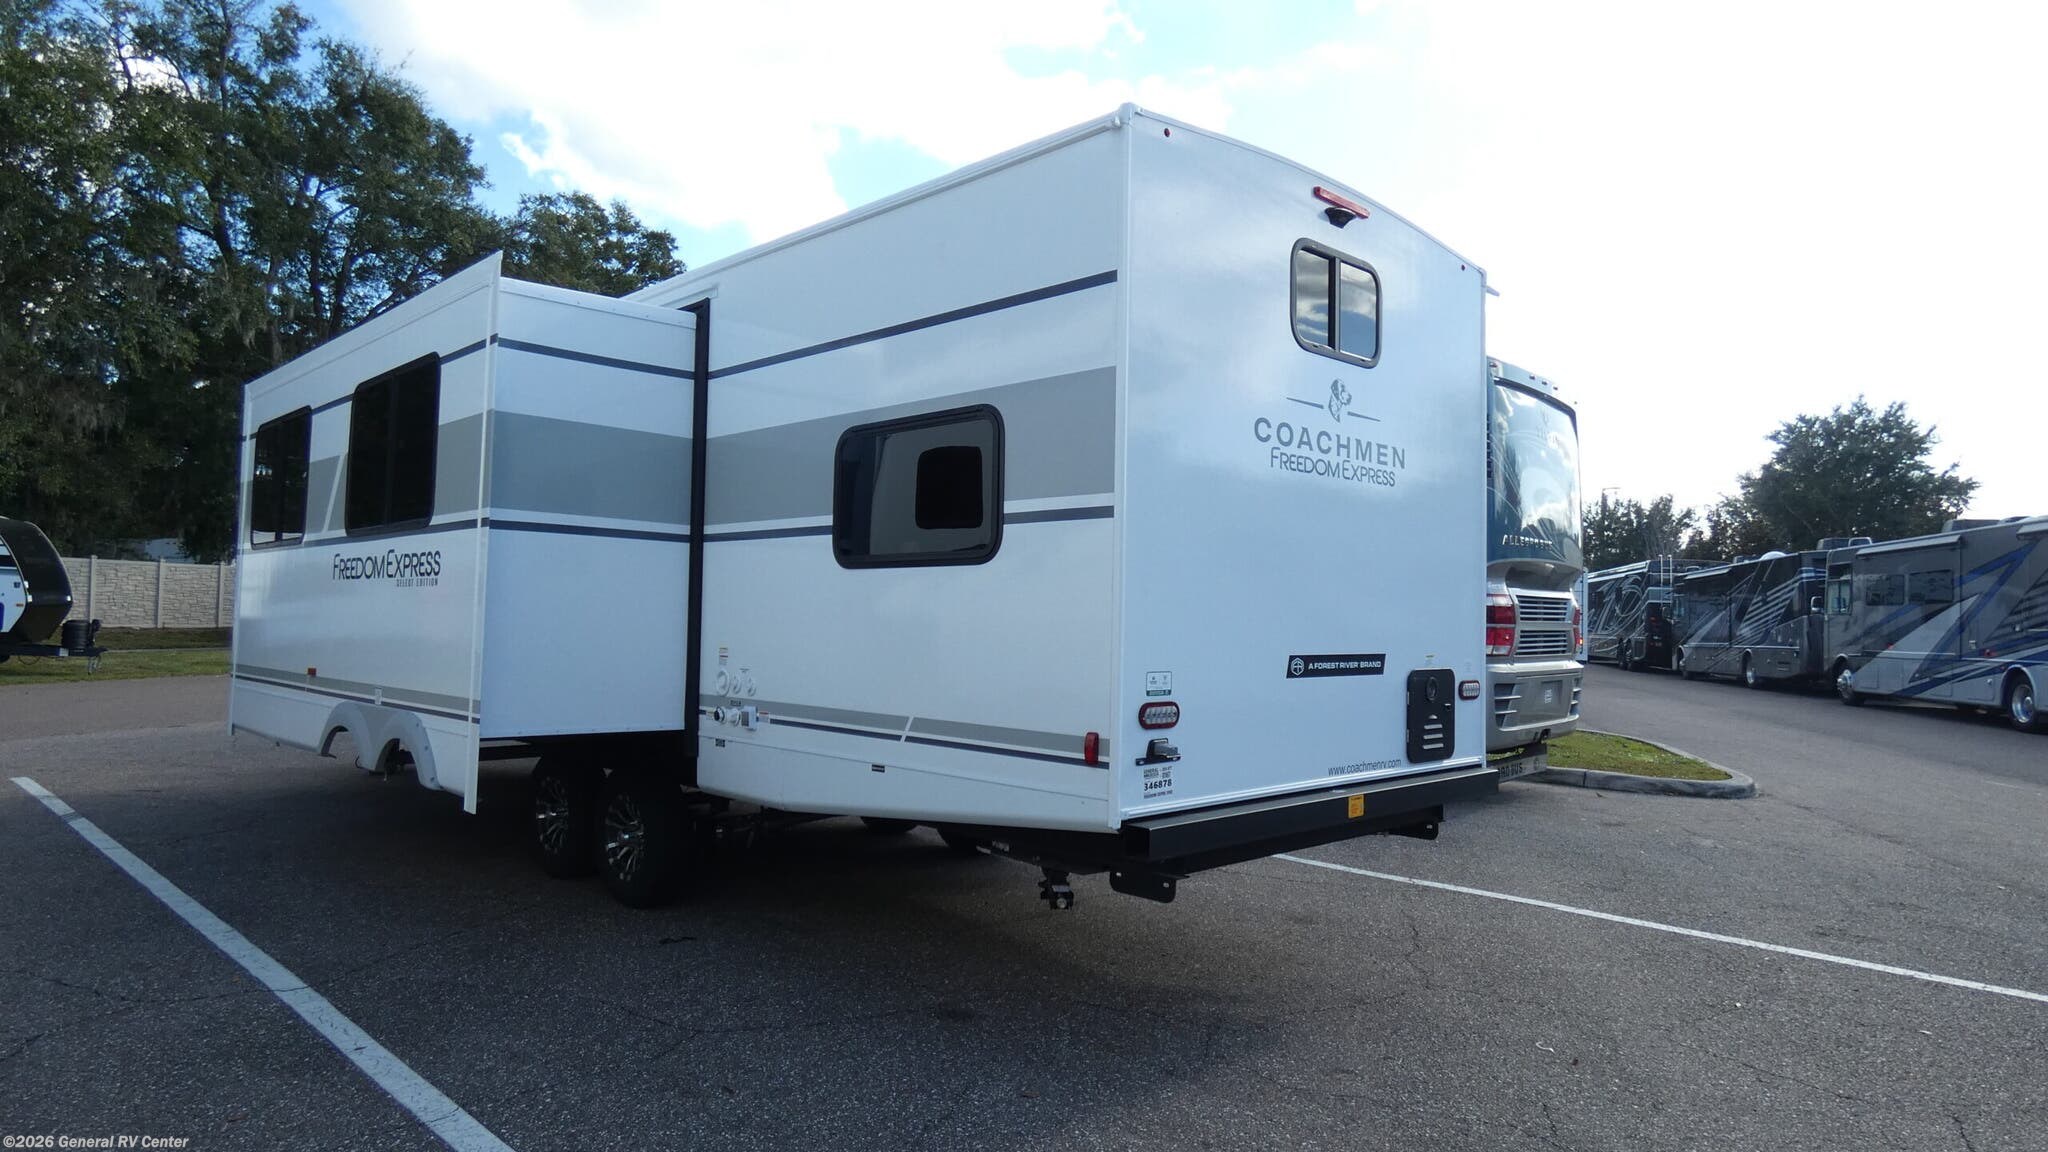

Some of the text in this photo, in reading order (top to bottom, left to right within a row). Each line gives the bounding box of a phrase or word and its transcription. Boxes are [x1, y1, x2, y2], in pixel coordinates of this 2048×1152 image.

[1253, 416, 1406, 469] COACHMEN
[1314, 662, 1339, 670] FOREST
[1339, 661, 1358, 669] RIVER
